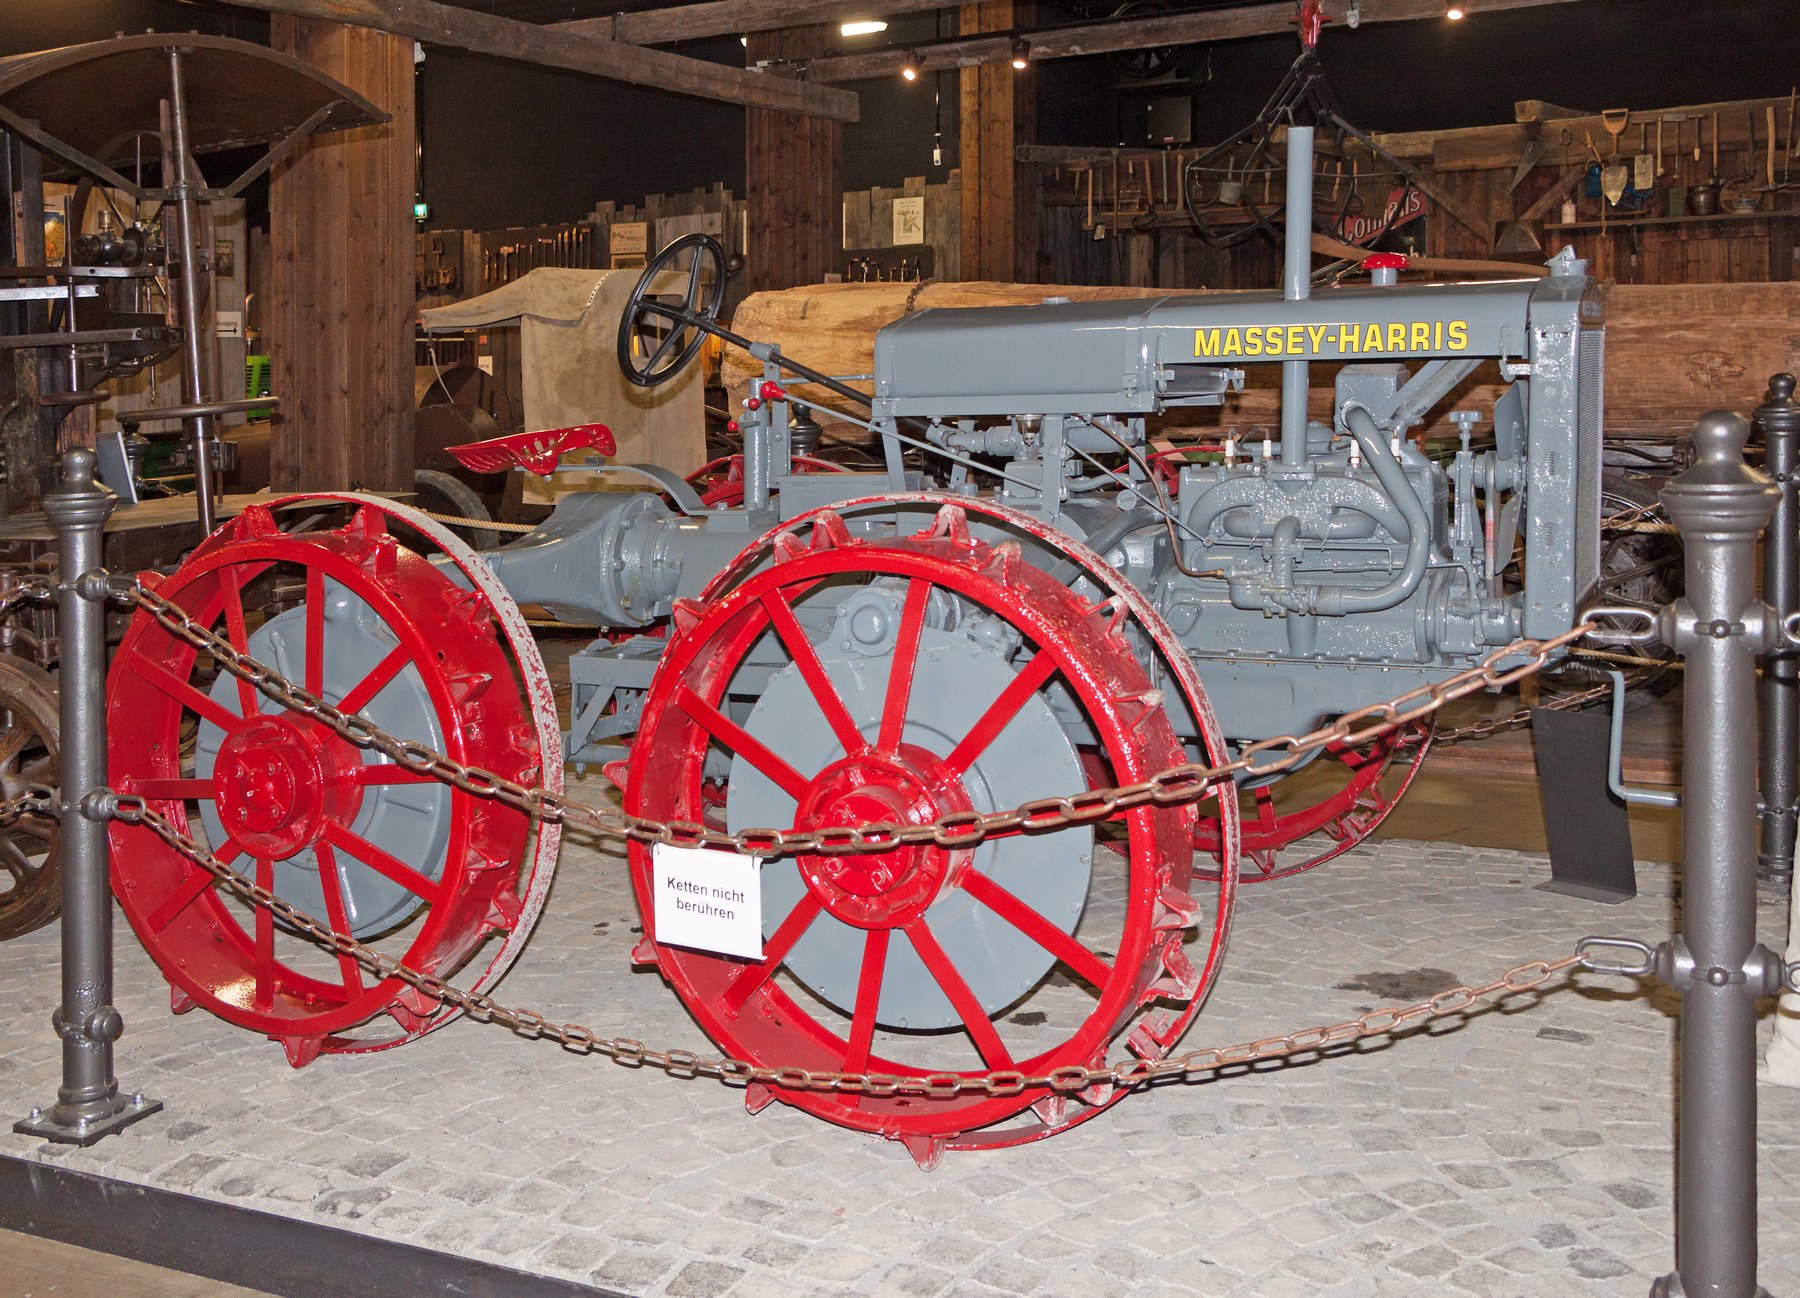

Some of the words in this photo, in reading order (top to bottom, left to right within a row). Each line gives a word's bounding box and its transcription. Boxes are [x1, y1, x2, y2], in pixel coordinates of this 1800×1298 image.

[1193, 320, 1468, 357] MASSEY-HARRIS
[667, 876, 708, 896] Ketten
[712, 886, 745, 904] nicht
[676, 897, 735, 920] berühren
